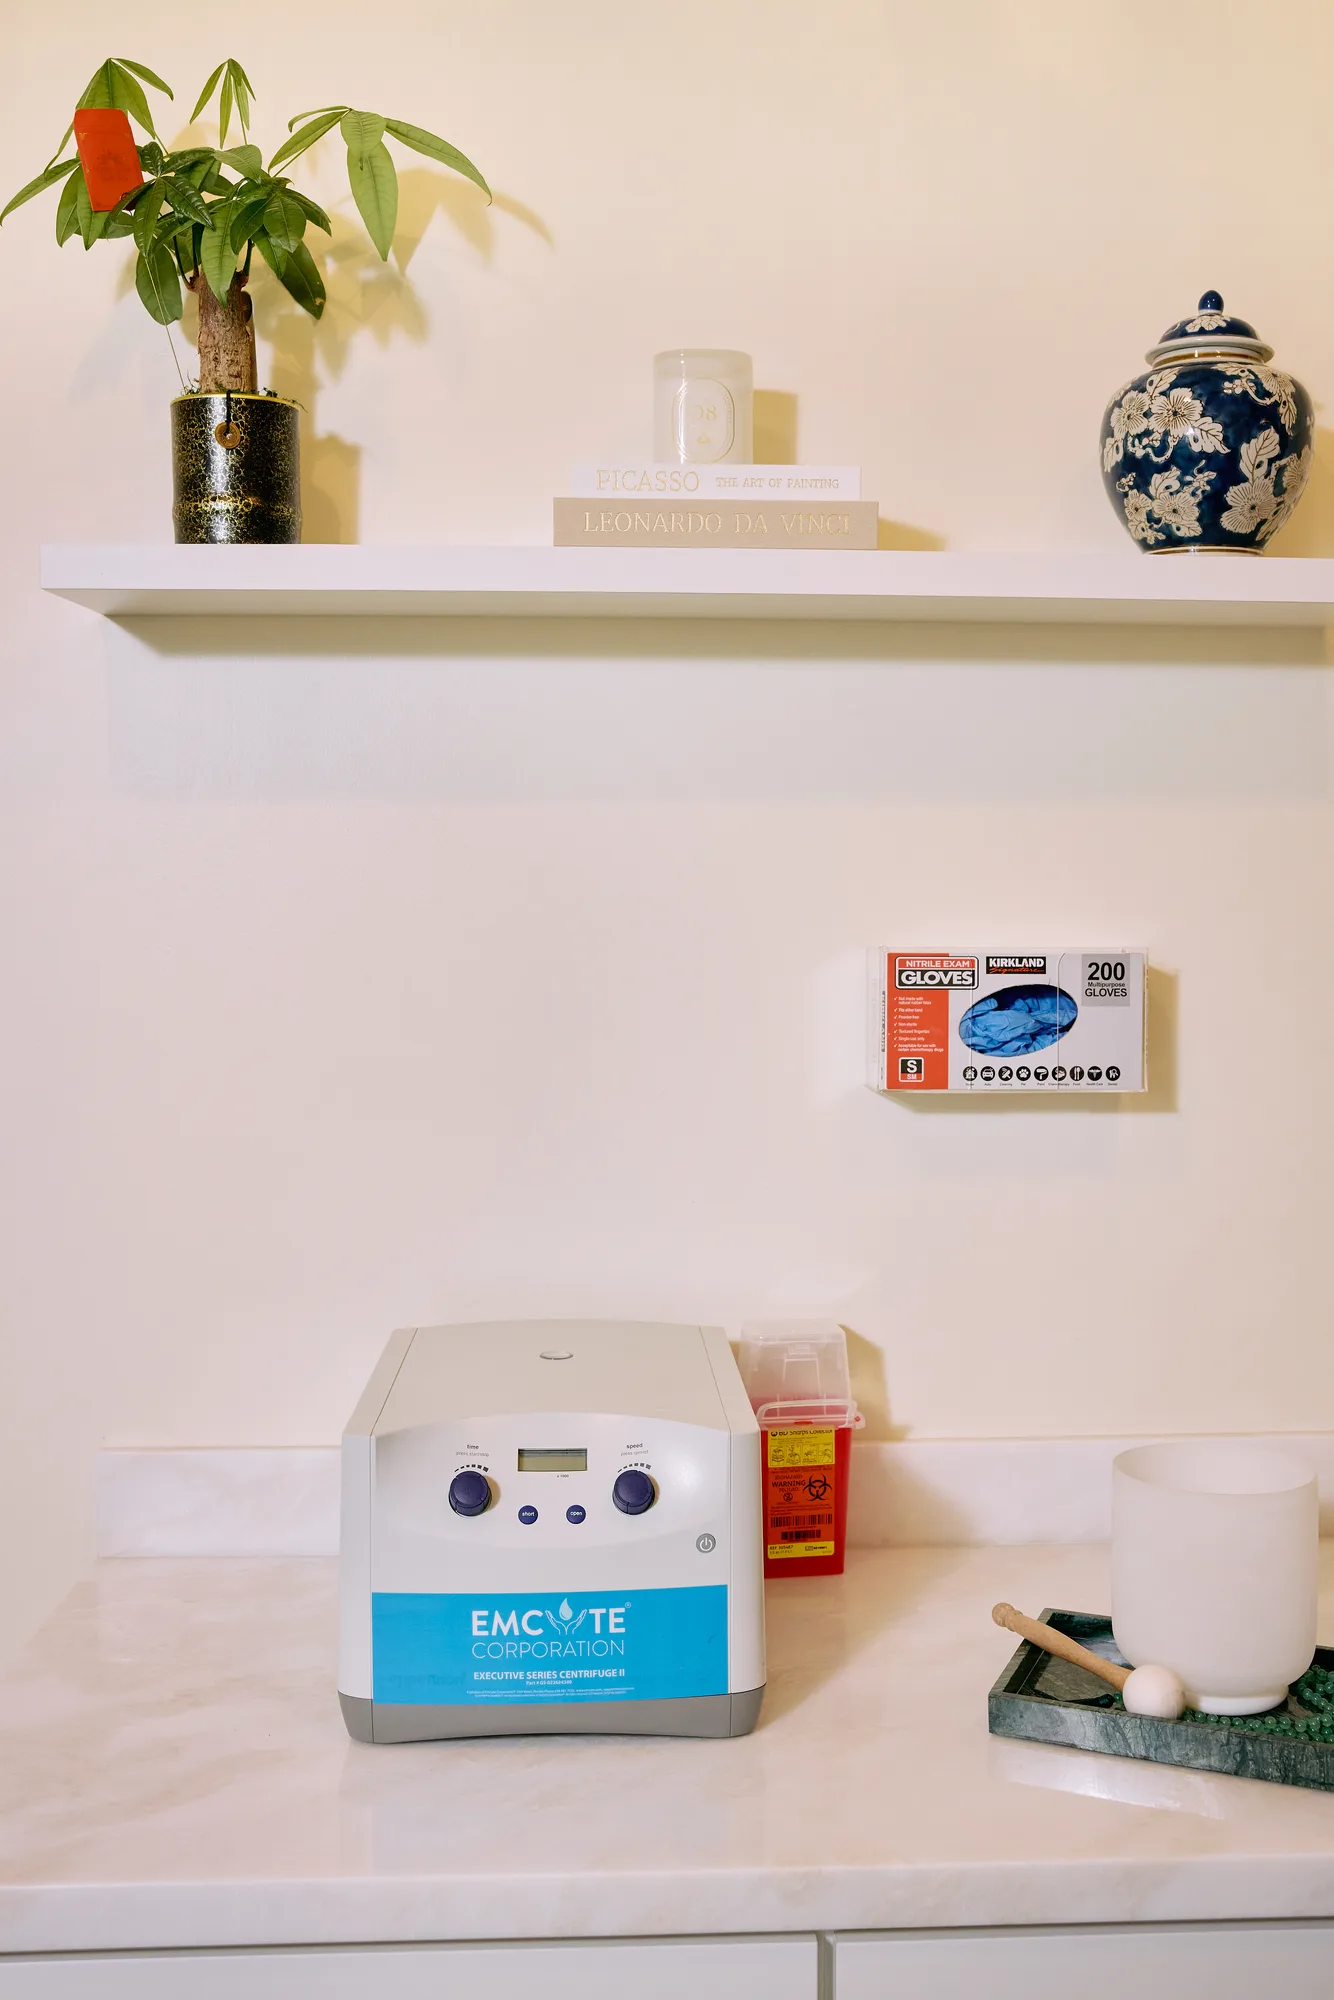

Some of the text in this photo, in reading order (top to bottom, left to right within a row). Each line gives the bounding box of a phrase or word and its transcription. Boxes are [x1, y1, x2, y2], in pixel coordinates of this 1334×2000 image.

[596, 469, 700, 492] PICASSO
[715, 477, 840, 489] THE ART OF PAINTING
[584, 511, 853, 536] LEONARDO DA VINCI
[906, 960, 970, 968] NITRILE EXAM
[989, 958, 1045, 967] KIRKLAND
[989, 966, 1045, 974] Signature
[1087, 961, 1126, 981] 200
[901, 970, 973, 985] GLOVES
[1085, 988, 1128, 997] GLOVES
[906, 1059, 918, 1074] S
[771, 1479, 806, 1488] WARNING
[471, 1639, 625, 1659] CORPORATION
[473, 1671, 524, 1680] EXECUTIVE
[526, 1670, 557, 1680] SERIES
[559, 1669, 617, 1679] CENTRIFUGE
